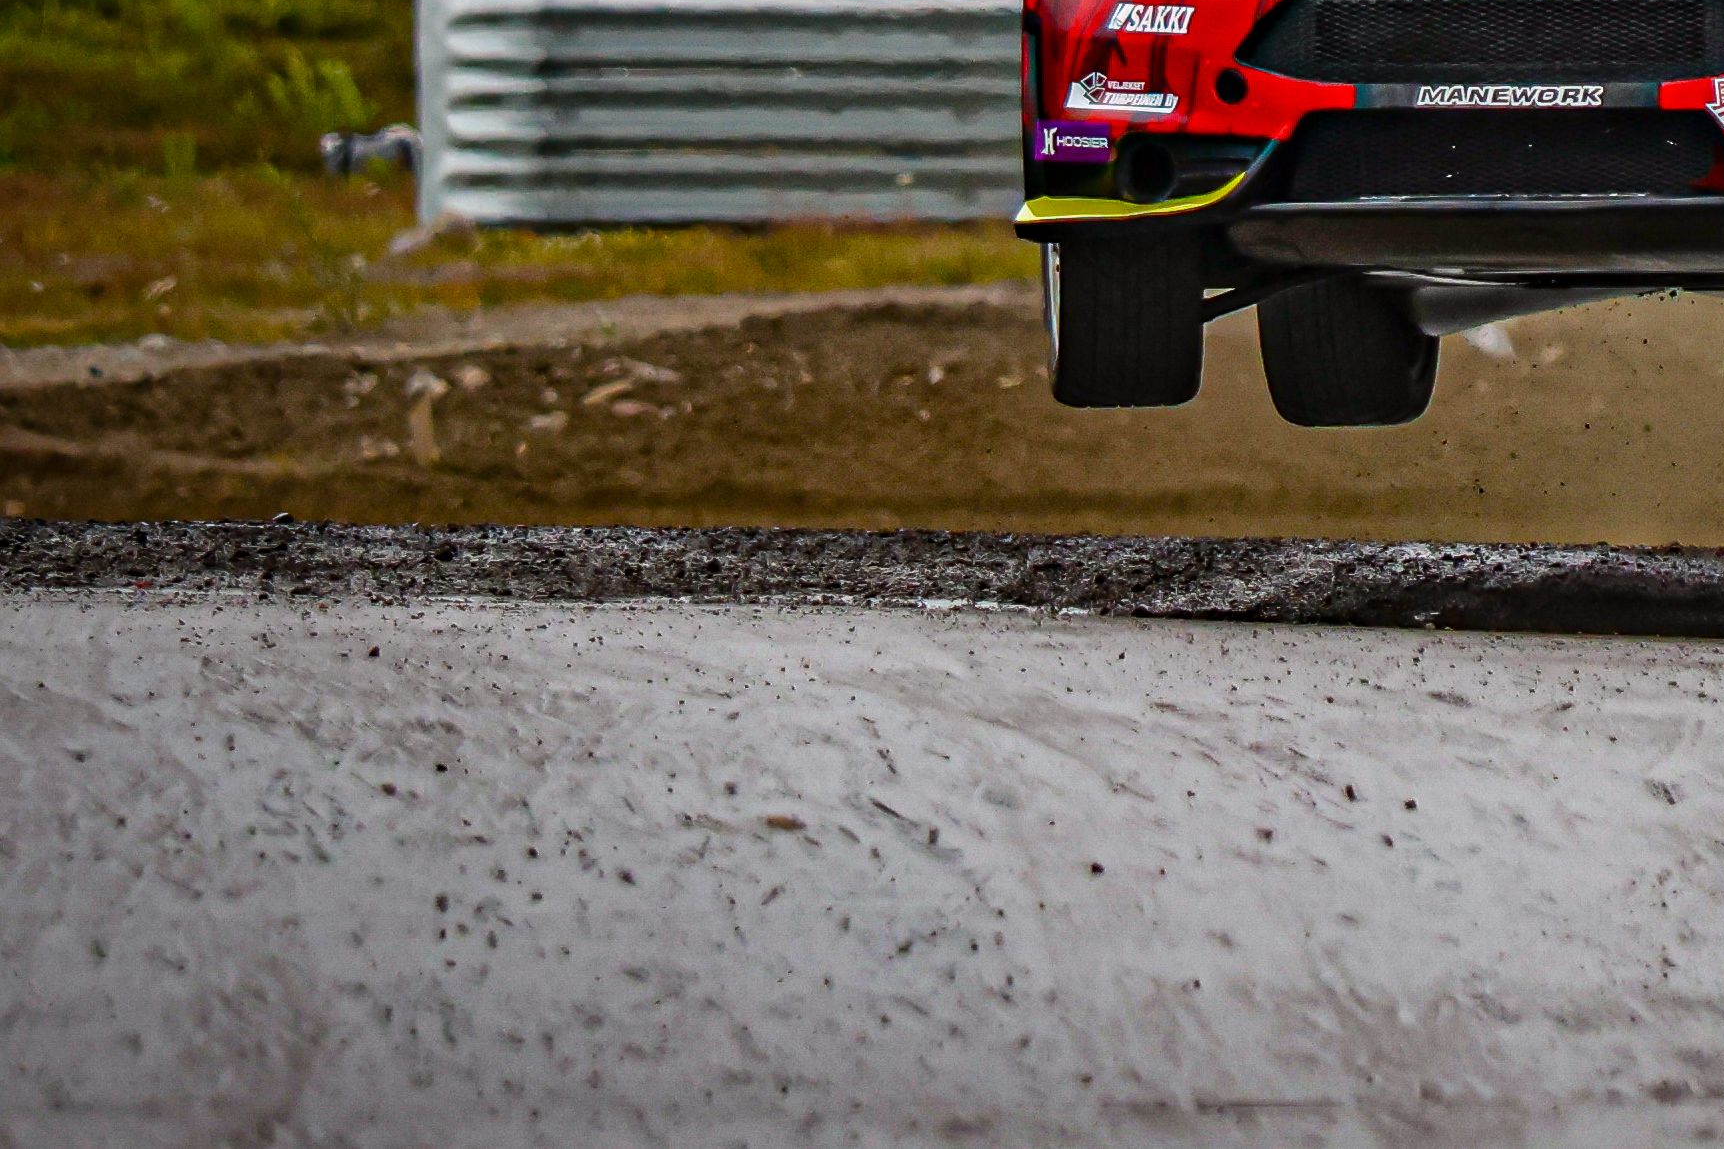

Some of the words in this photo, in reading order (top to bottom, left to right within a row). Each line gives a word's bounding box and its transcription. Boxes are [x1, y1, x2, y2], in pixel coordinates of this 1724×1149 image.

[1125, 3, 1195, 34] SAKKI
[1103, 92, 1163, 107] TURPEINEN
[1415, 84, 1604, 107] MANEWORK
[1056, 135, 1109, 149] HOOSIER
